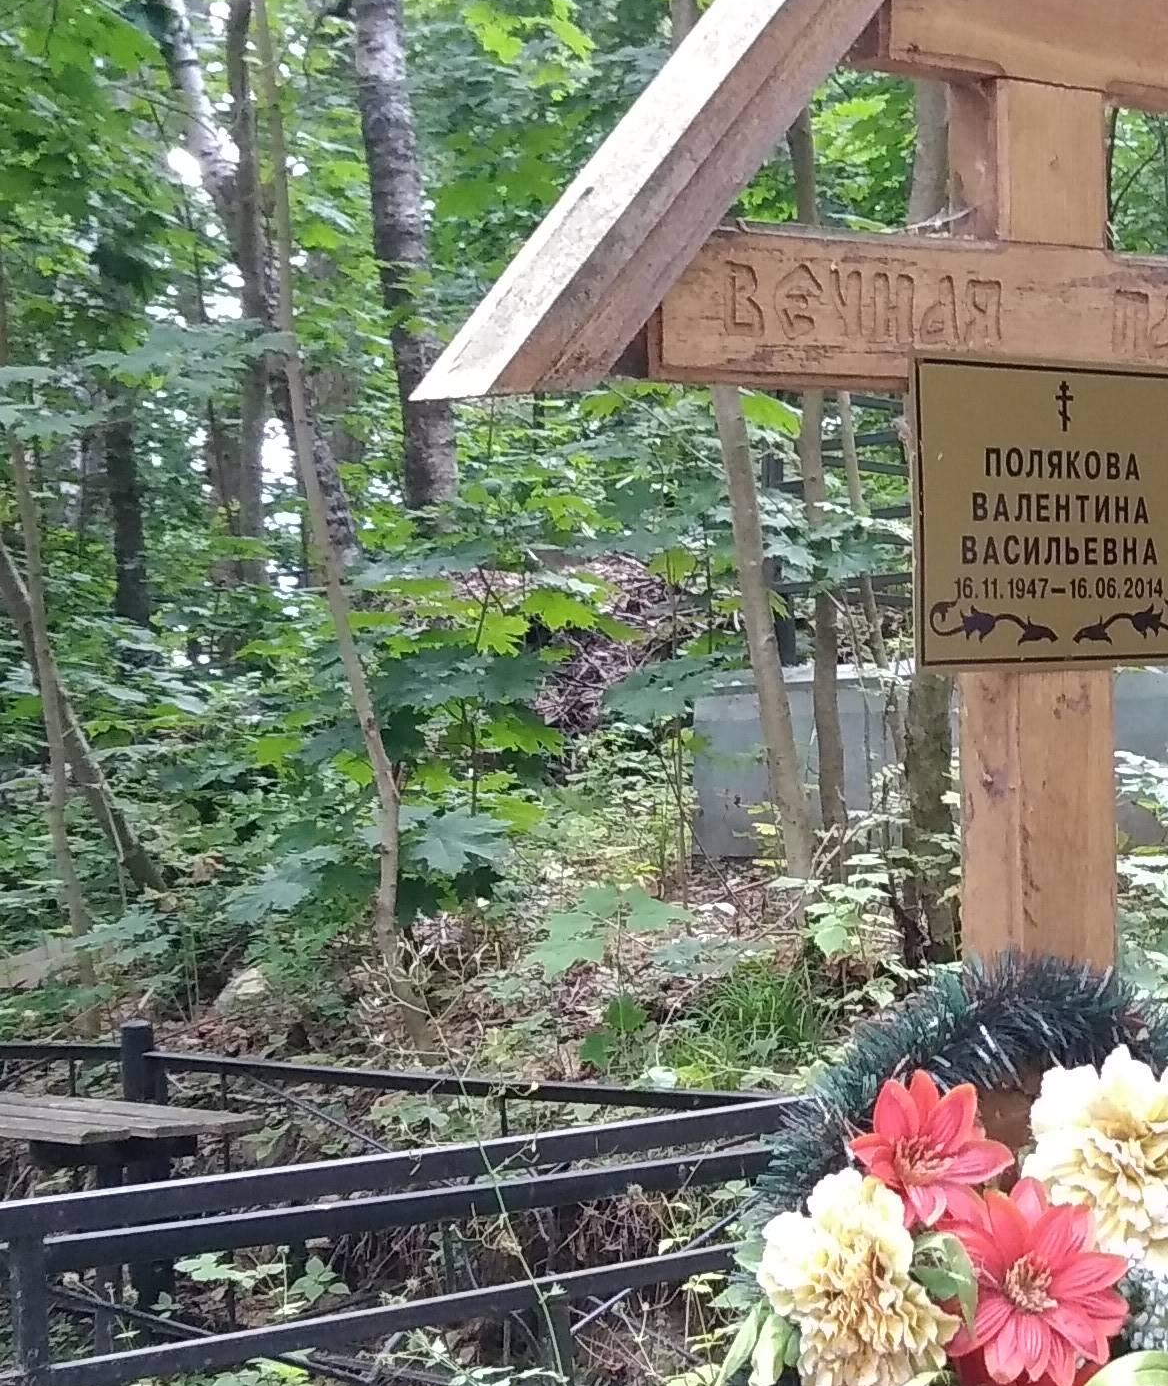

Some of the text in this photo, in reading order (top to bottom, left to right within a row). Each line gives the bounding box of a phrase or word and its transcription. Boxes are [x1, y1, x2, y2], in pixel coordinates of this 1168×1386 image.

[985, 447, 1140, 481] ПОЛЯКОВА
[971, 492, 1149, 525] ВАЛЕНТИНА
[961, 535, 1158, 566] ВАСИЛЬЕВНА
